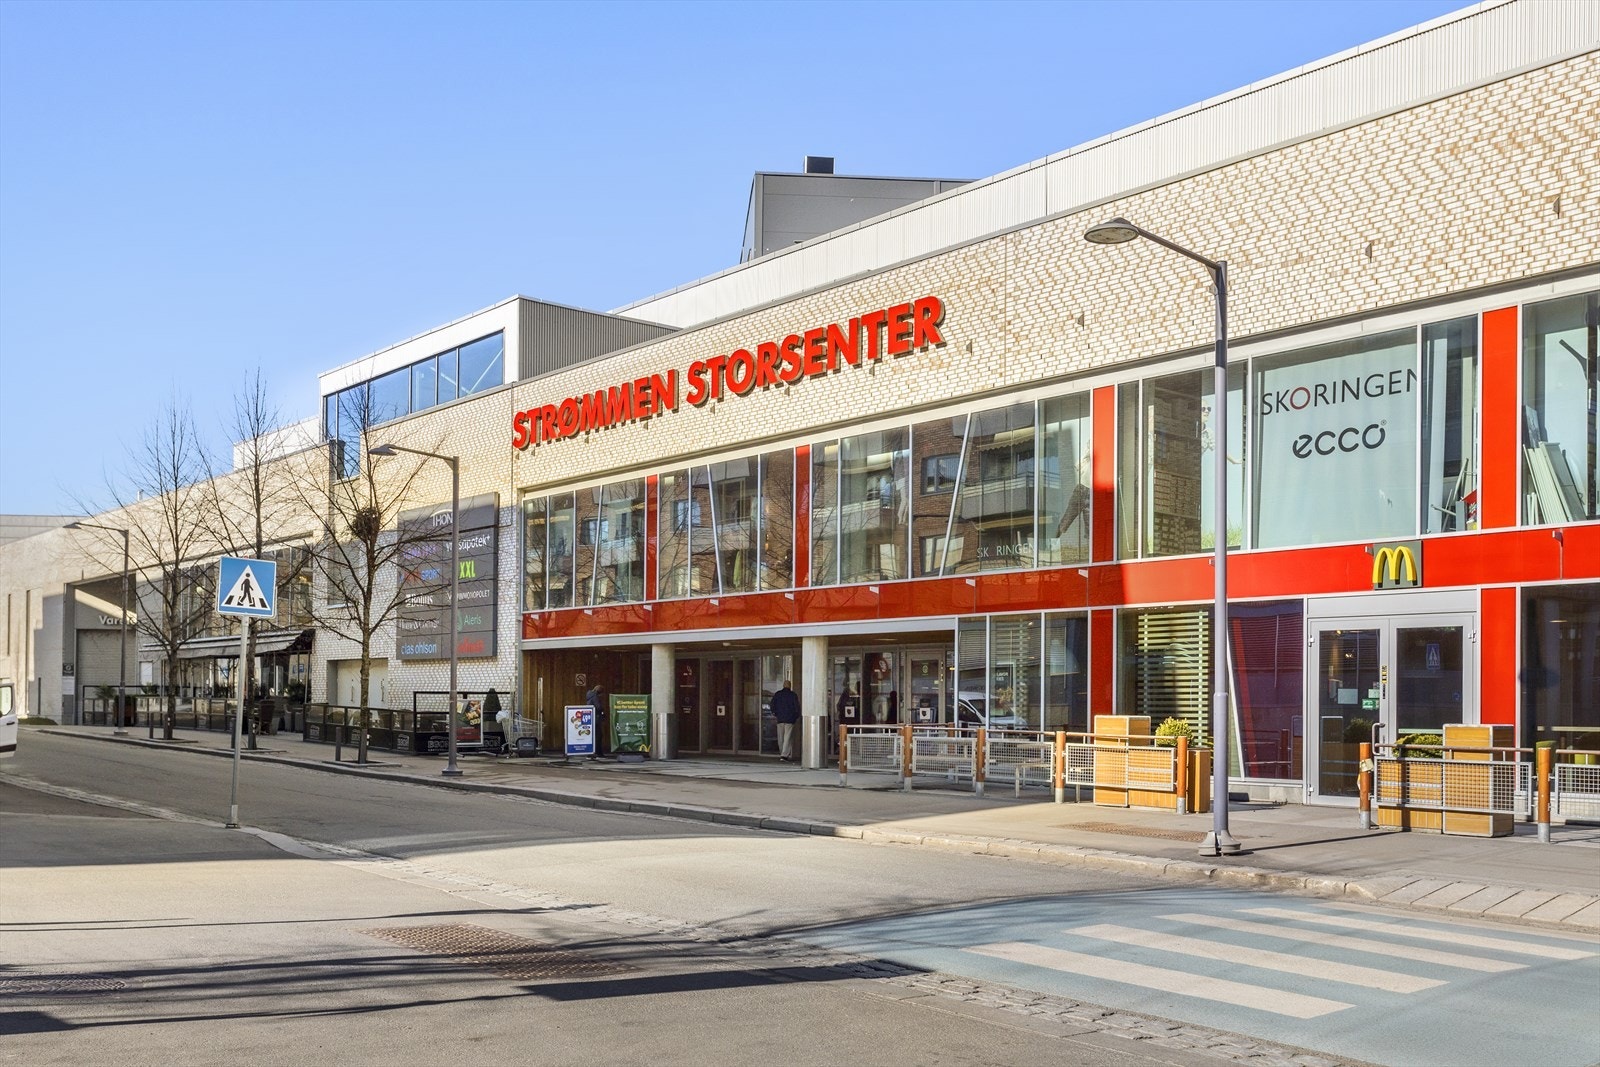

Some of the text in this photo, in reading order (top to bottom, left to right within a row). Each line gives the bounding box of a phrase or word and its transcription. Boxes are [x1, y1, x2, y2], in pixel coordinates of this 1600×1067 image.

[512, 296, 946, 450] STRØMMEN STORSENTER
[1292, 423, 1386, 458] ecco
[432, 512, 453, 526] THON
[460, 560, 476, 579] XXL
[464, 613, 482, 626] Aleris
[414, 641, 437, 655] ohlson
